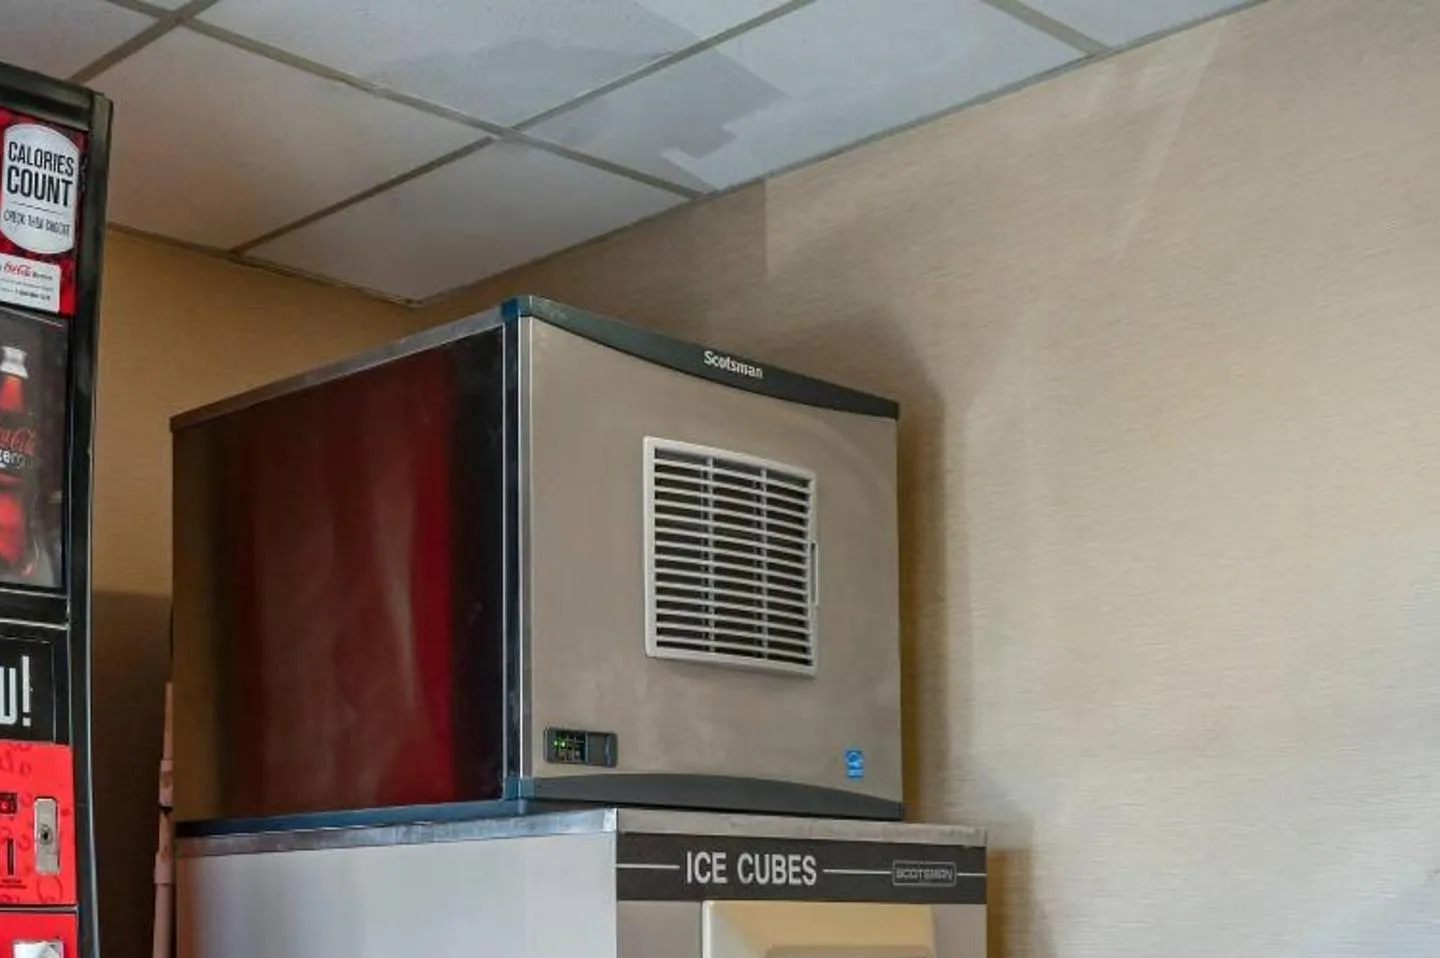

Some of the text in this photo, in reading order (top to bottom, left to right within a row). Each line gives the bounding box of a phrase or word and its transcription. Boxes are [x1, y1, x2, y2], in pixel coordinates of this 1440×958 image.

[8, 141, 74, 177] CALORIES
[6, 165, 73, 207] COUNT
[703, 350, 764, 379] Scotsman
[686, 851, 817, 886] ICE CUBES
